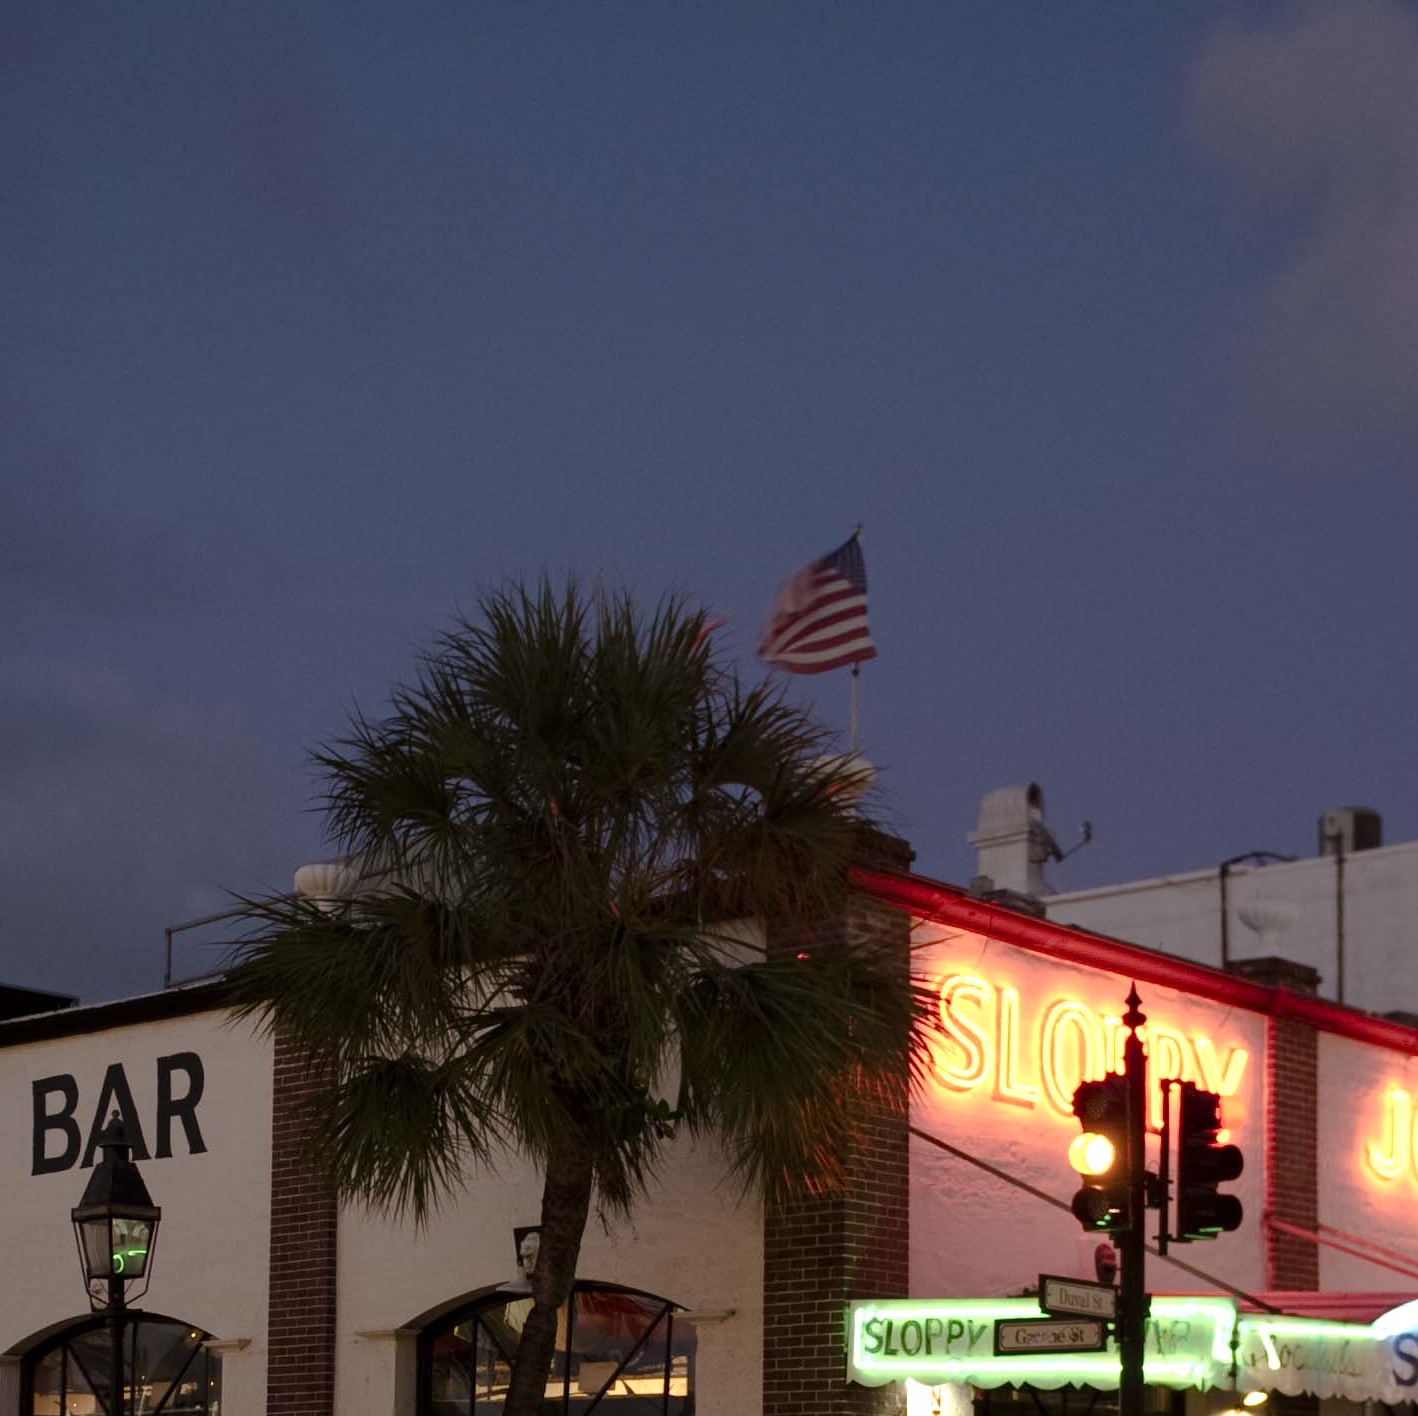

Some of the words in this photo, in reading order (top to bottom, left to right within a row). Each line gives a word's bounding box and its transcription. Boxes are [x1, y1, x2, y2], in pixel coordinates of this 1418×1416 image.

[31, 1050, 207, 1177] BAR
[1059, 1287, 1090, 1309] Duval
[864, 1317, 988, 1357] SLOPPY
[1068, 1326, 1085, 1344] St
